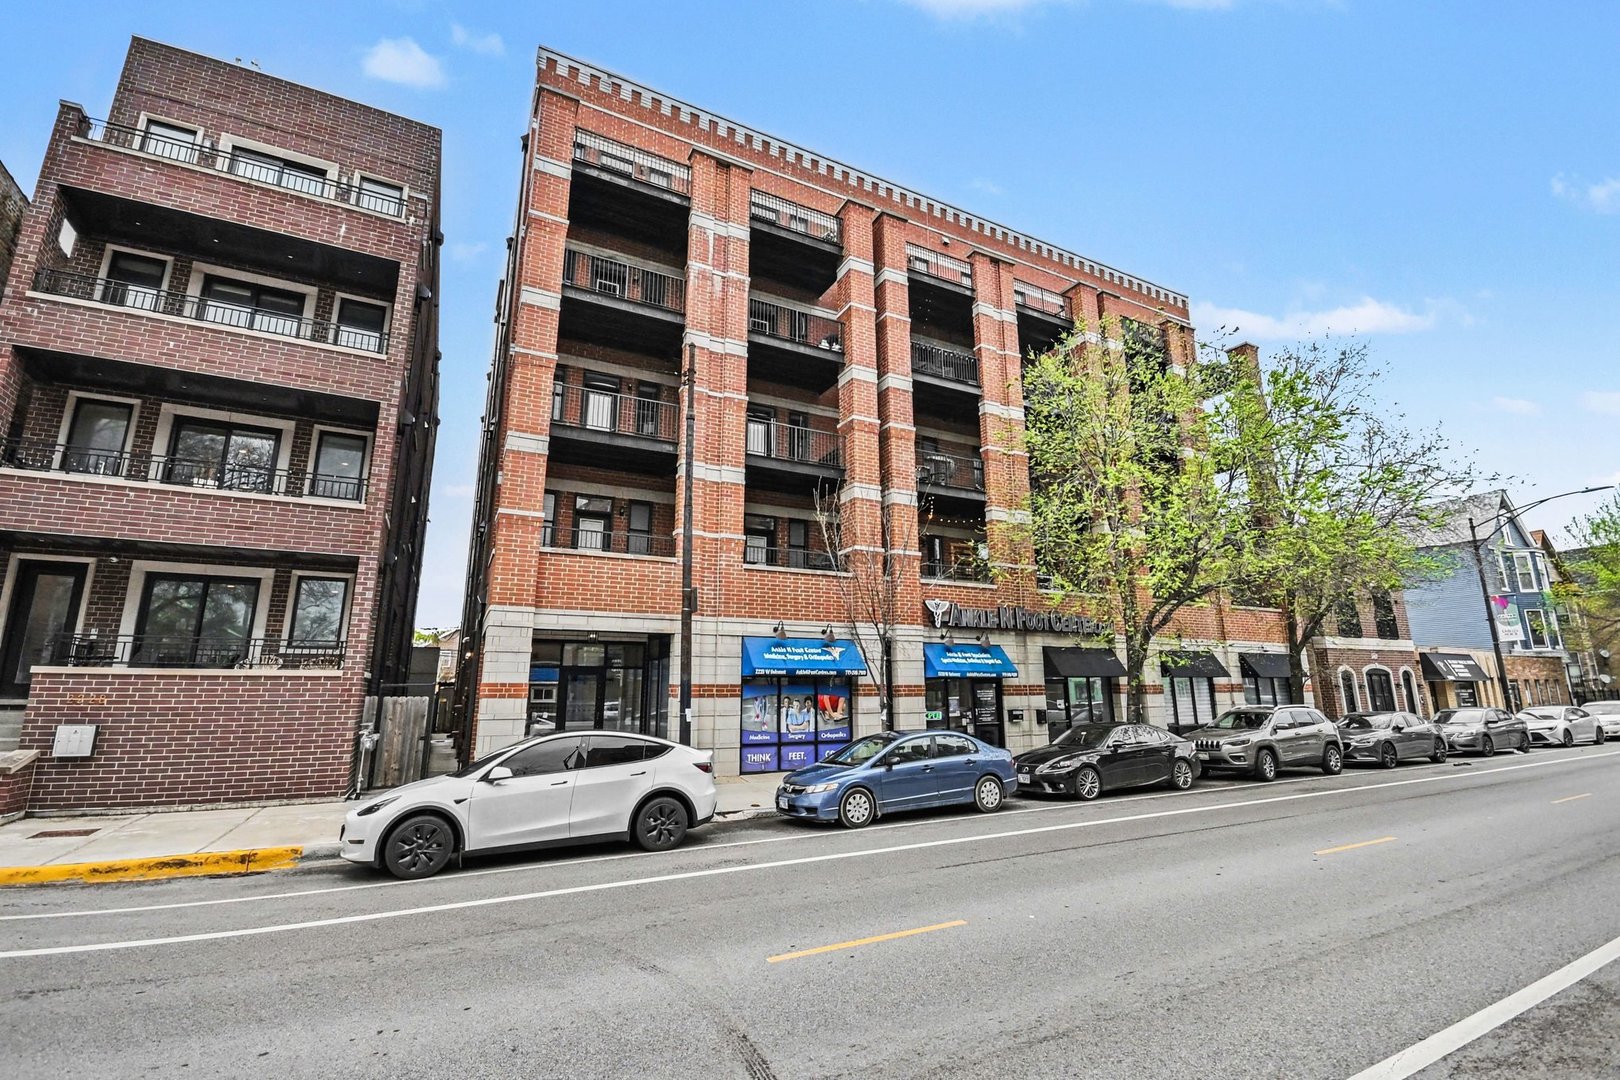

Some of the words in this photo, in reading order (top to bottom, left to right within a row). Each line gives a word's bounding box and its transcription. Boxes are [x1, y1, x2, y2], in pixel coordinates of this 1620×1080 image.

[949, 603, 999, 628] ANKLE
[1016, 606, 1049, 631] FOOT
[747, 753, 771, 762] THINK
[788, 751, 807, 760] FEET.
